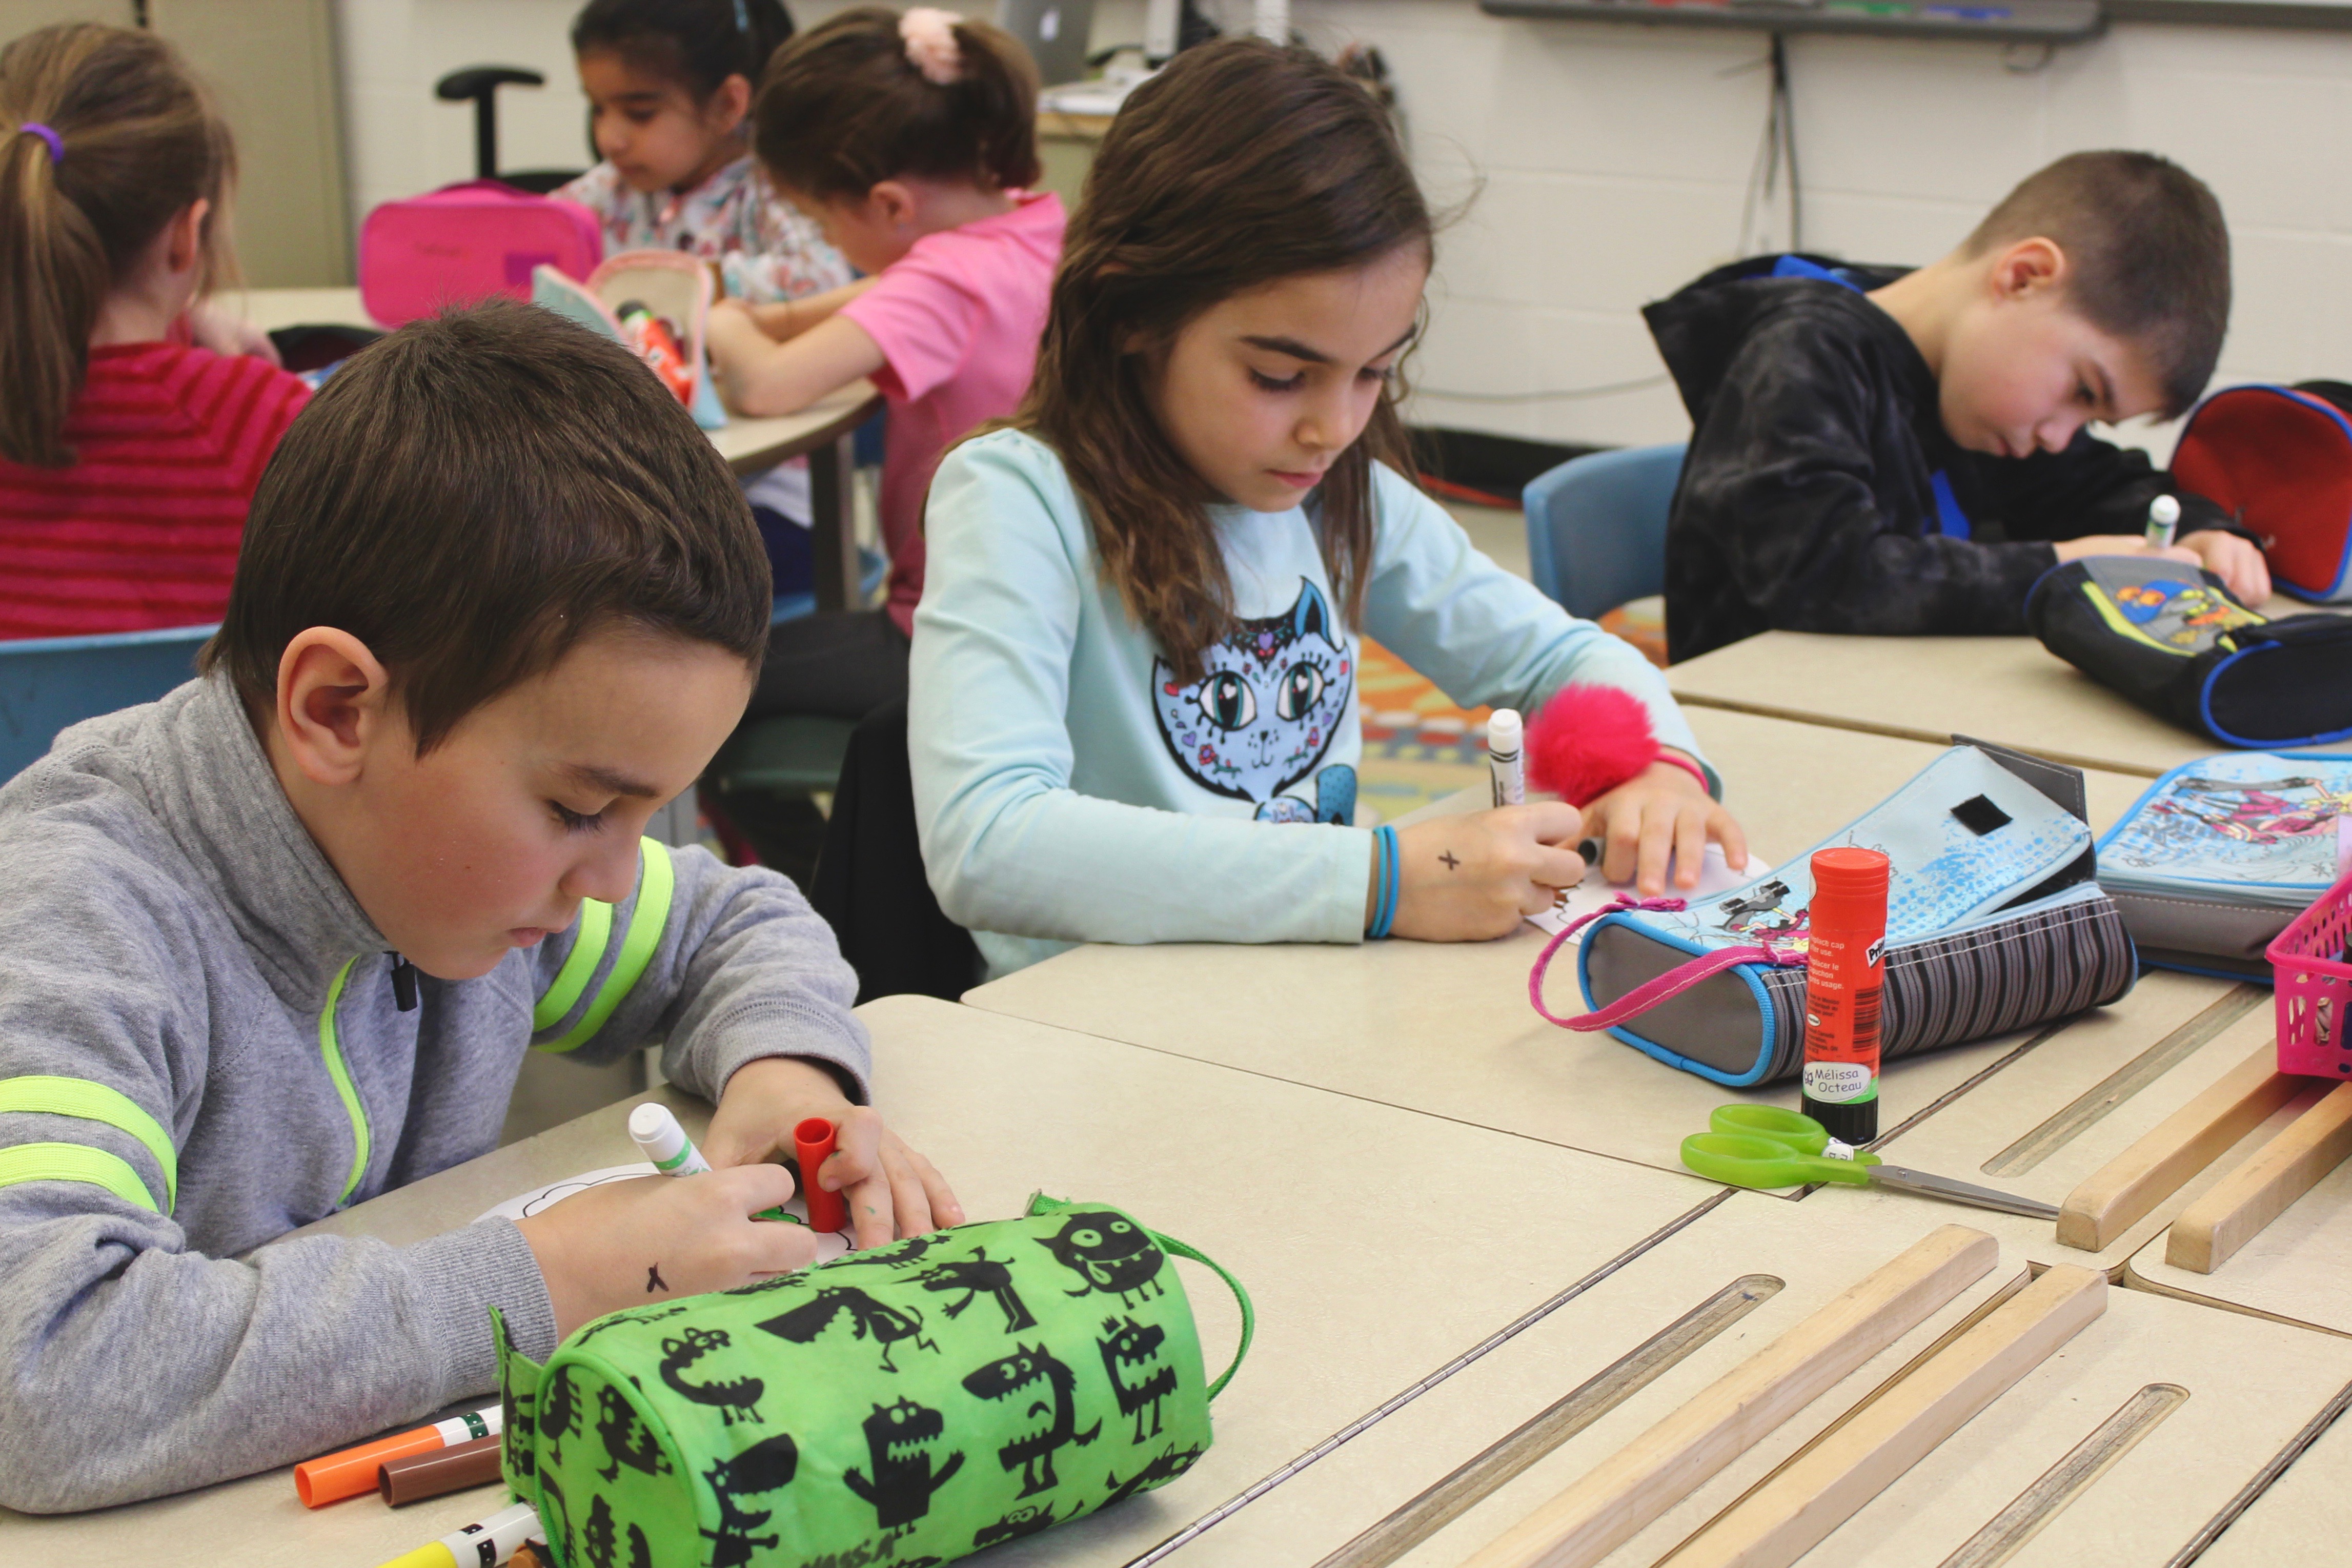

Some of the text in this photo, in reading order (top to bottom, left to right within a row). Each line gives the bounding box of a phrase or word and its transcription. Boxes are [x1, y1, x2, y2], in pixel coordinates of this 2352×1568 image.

[1810, 934, 1844, 950] place cap
[1809, 955, 1830, 969] placer
[1809, 966, 1833, 979] puchon
[1821, 981, 1844, 990] usage.
[1815, 1069, 1858, 1080] Mélissa
[1818, 1082, 1861, 1093] Octeau
